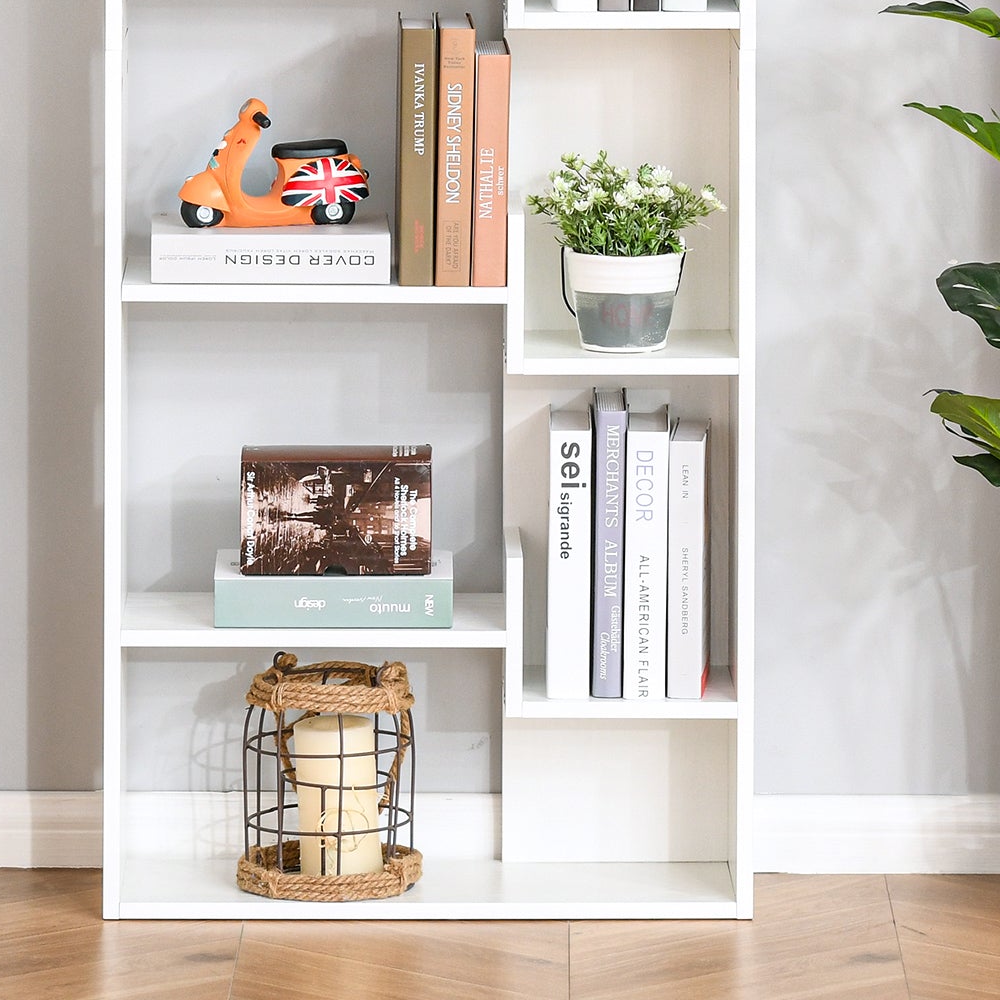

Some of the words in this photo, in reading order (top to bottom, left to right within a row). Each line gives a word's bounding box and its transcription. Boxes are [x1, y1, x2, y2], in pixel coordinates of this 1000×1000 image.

[414, 63, 424, 109] IVANKA
[447, 83, 462, 132] SIDNEY
[414, 112, 424, 155] TRUMP
[445, 135, 462, 204] SHELDON
[225, 255, 300, 265] DESIGN
[309, 255, 374, 265] COVER
[560, 442, 586, 488] sei
[605, 425, 620, 528] MERCHANTS
[636, 451, 653, 522] DECOR
[604, 540, 617, 597] ALBUM
[294, 597, 326, 611] design
[370, 601, 411, 613] muuto
[425, 594, 434, 616] NEW
[638, 555, 650, 654] ALL-AMERICAN
[638, 660, 649, 698] FLAIR
